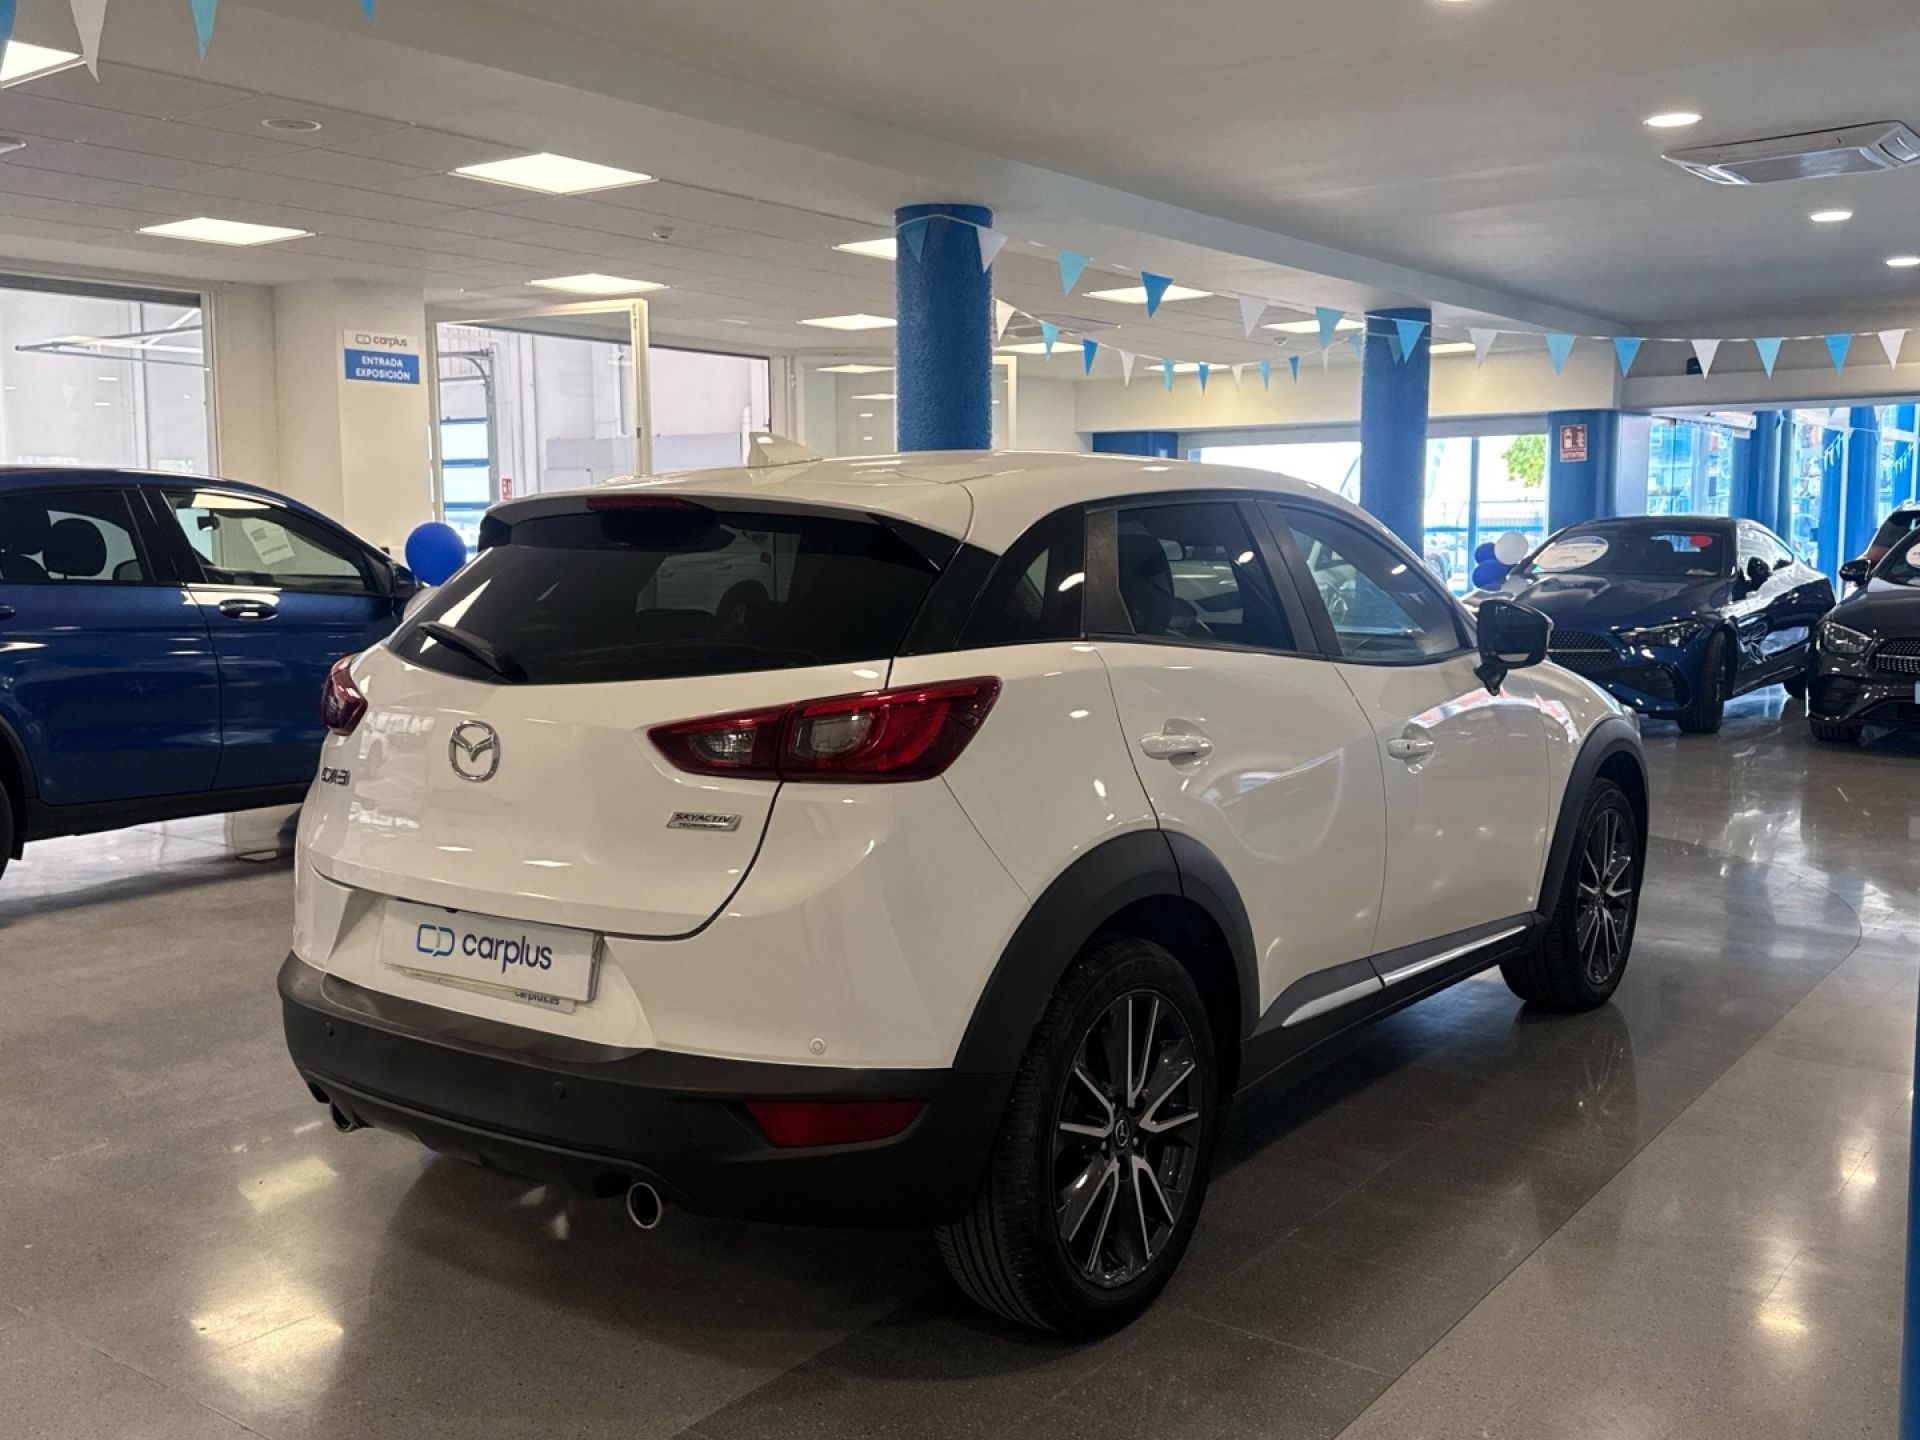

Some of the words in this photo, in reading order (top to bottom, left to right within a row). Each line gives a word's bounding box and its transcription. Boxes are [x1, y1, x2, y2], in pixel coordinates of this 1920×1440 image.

[373, 335, 408, 348] carplus
[361, 355, 404, 368] ENTRADA
[355, 367, 410, 381] EXPOSICIÓN
[674, 813, 732, 823] SKYACTIV
[462, 933, 553, 974] carplus
